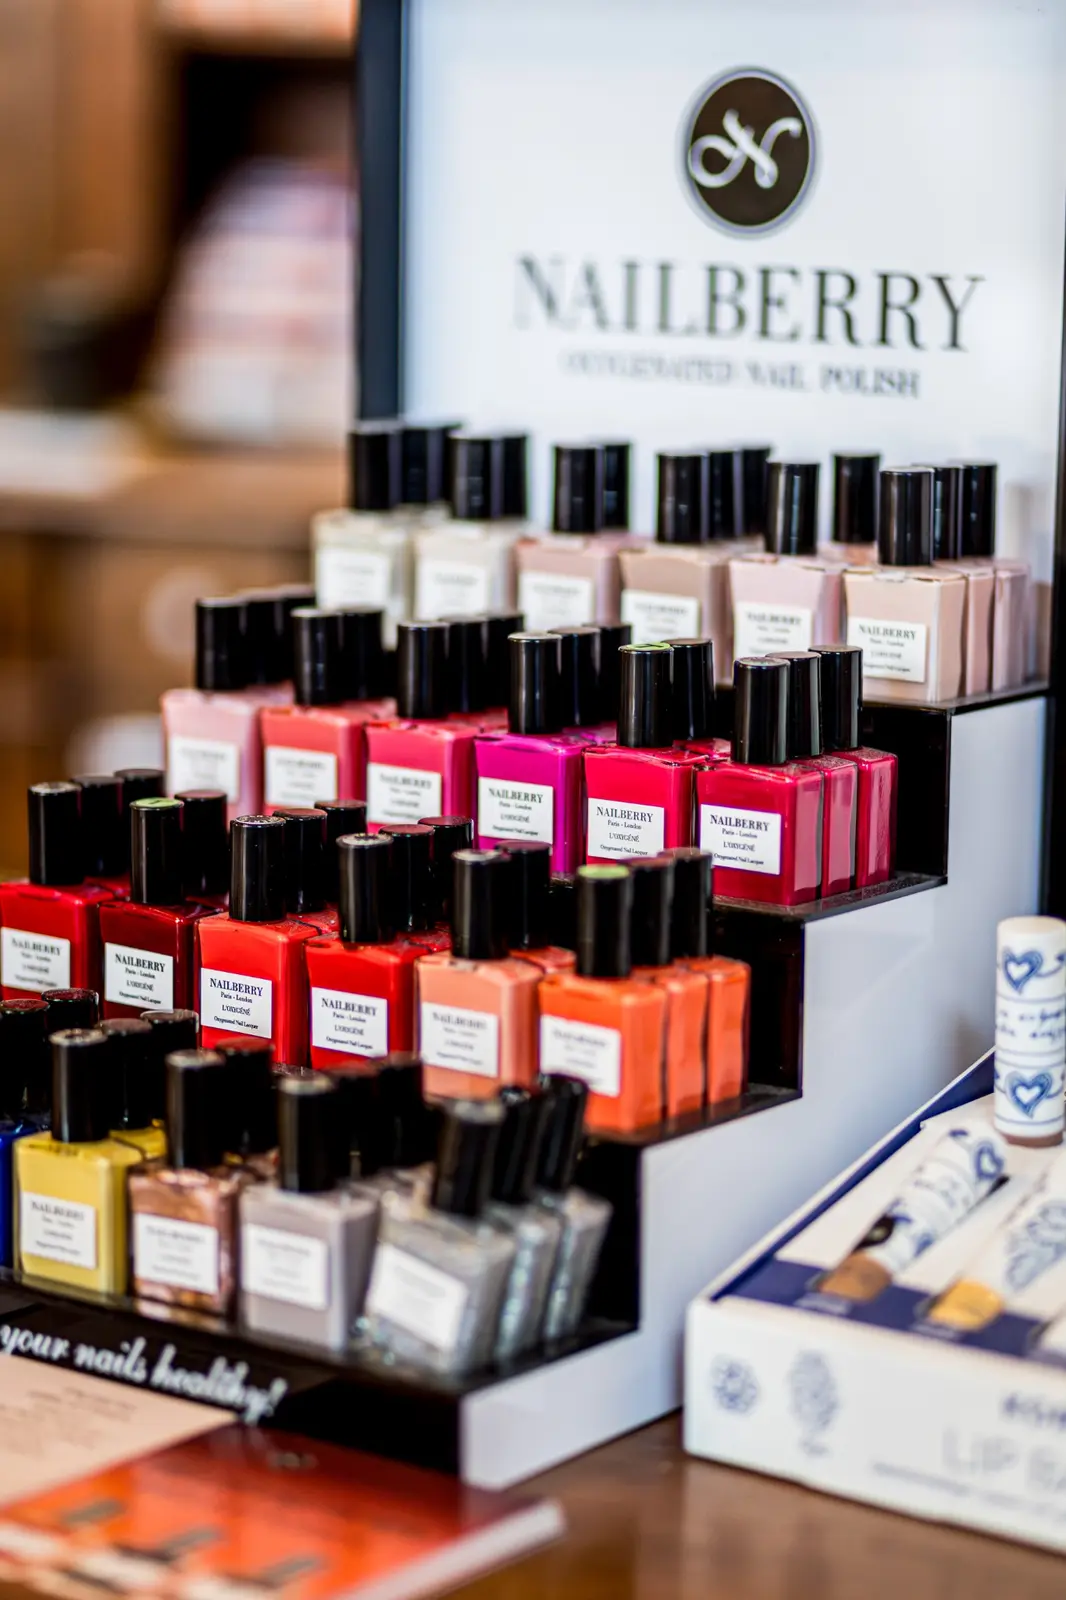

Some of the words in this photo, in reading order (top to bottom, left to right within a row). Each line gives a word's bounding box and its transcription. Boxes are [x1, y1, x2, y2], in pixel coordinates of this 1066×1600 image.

[513, 254, 986, 353] NAILBERRY
[744, 358, 804, 391] NAIL
[820, 362, 921, 399] POLISH
[858, 624, 916, 641] NAILBERRY
[488, 787, 544, 804] NAILBERRY
[596, 806, 653, 823] NAILBERRY
[710, 814, 770, 832] NAILBERRY
[607, 819, 620, 827] Paris
[624, 821, 642, 830] London
[721, 827, 735, 836] Paris
[739, 830, 758, 839] London
[11, 937, 62, 957] NAILBERRY
[115, 953, 166, 973] NAILBERRY
[139, 970, 156, 979] London
[209, 977, 264, 997] NAILBERRY
[220, 990, 232, 1000] Paris
[236, 994, 253, 1004] London
[321, 997, 378, 1017] NAILBERRY
[0, 1324, 70, 1361] your
[73, 1336, 148, 1383] nails
[151, 1343, 288, 1425] healthy!
